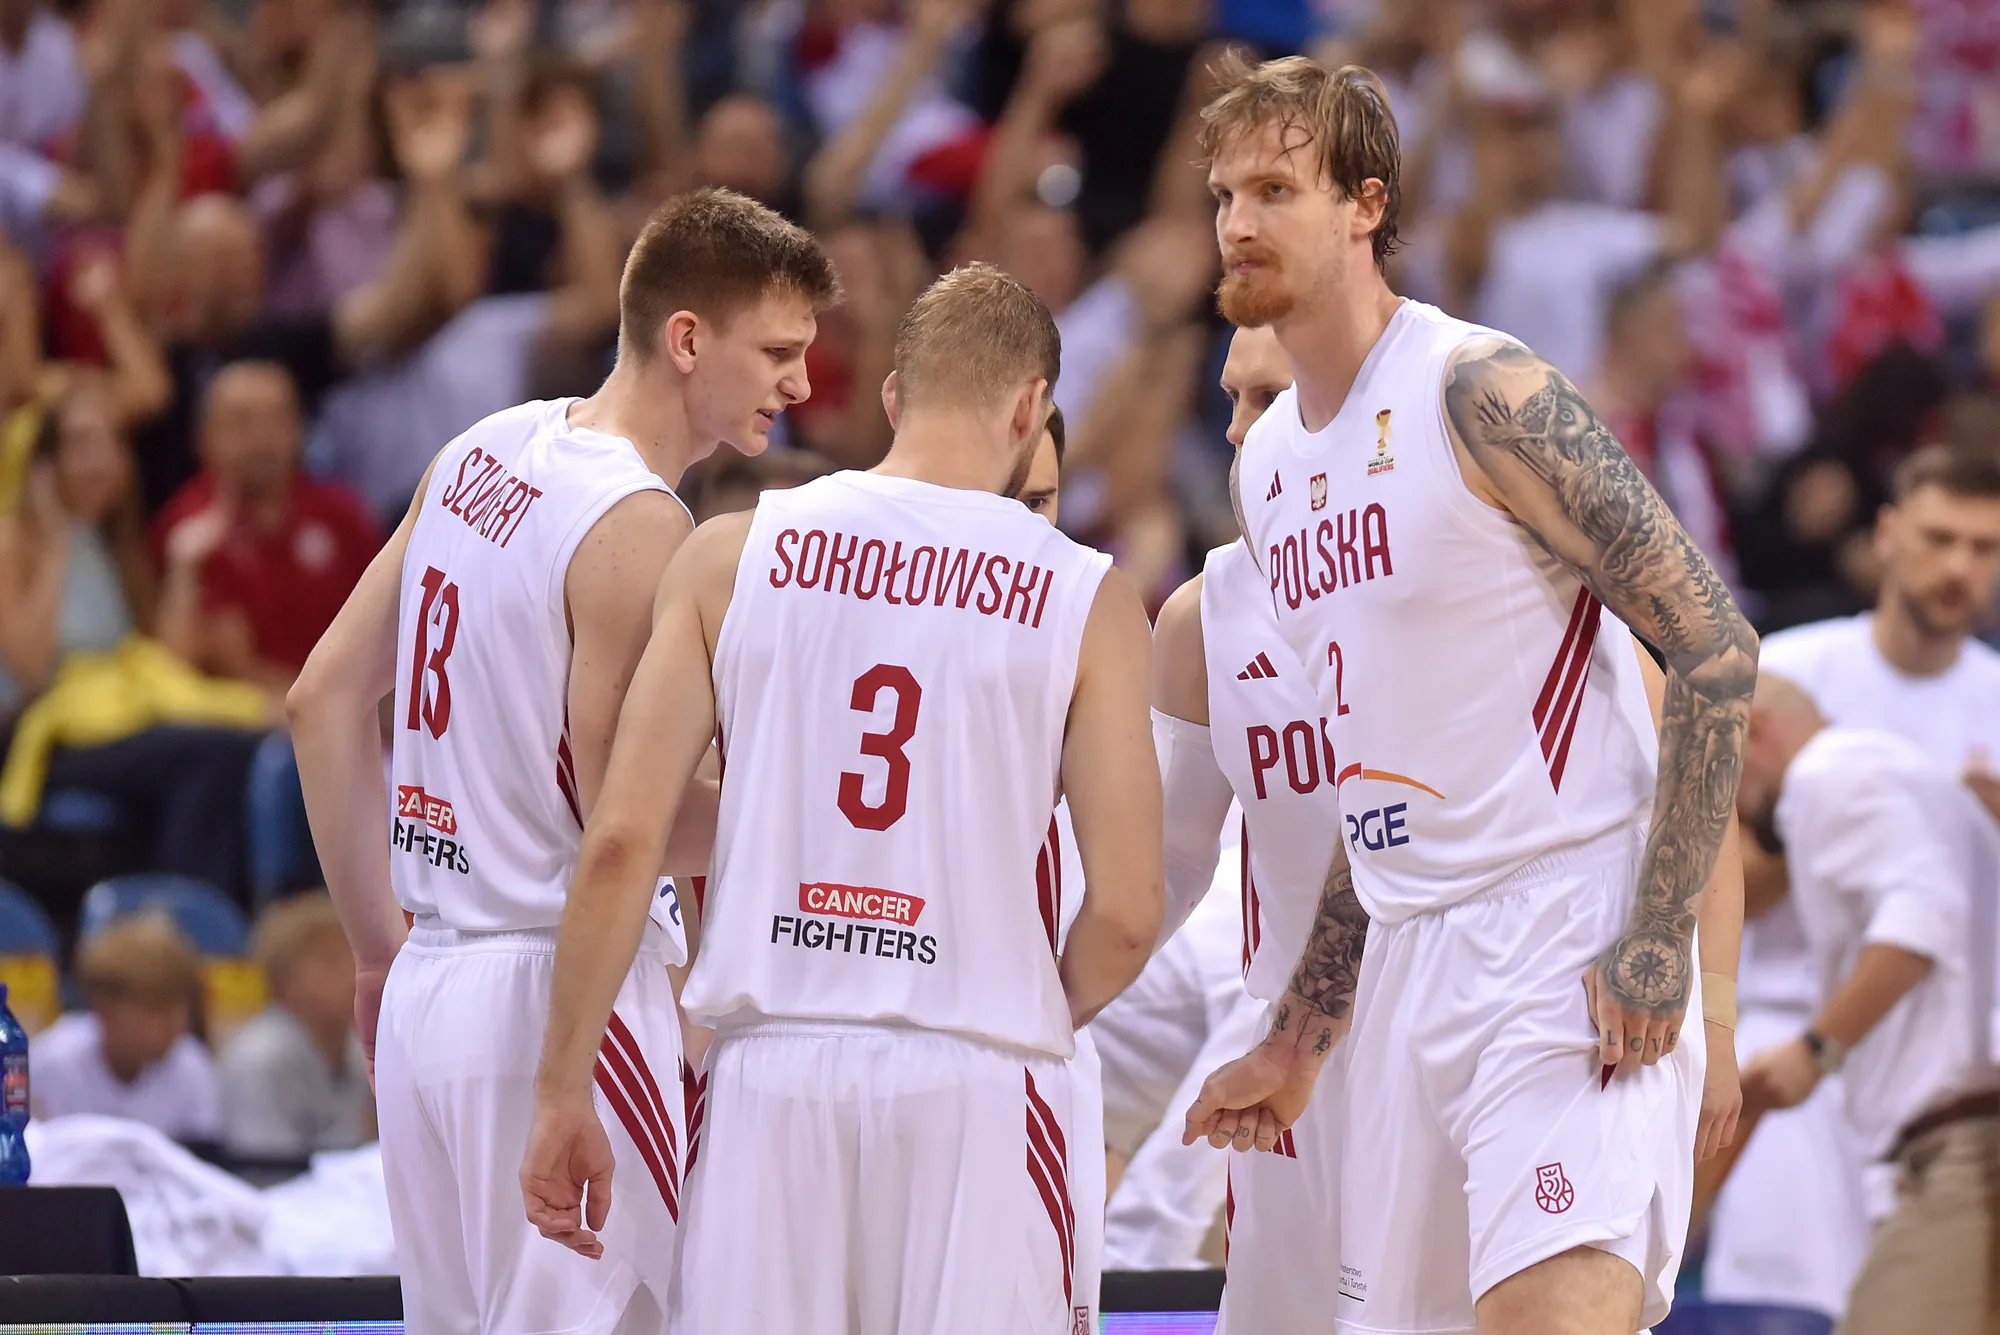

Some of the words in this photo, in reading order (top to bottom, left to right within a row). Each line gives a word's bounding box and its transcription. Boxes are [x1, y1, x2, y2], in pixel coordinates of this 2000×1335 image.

[769, 528, 1054, 629] SOKOŁOWSKI
[1270, 502, 1393, 620] POLSKA
[407, 565, 460, 741] 13
[836, 663, 923, 832] 3
[1346, 802, 1410, 853] PGE
[770, 915, 937, 966] FIGHTERS
[807, 886, 912, 922] CANCER
[1606, 1030, 1678, 1053] LOVE
